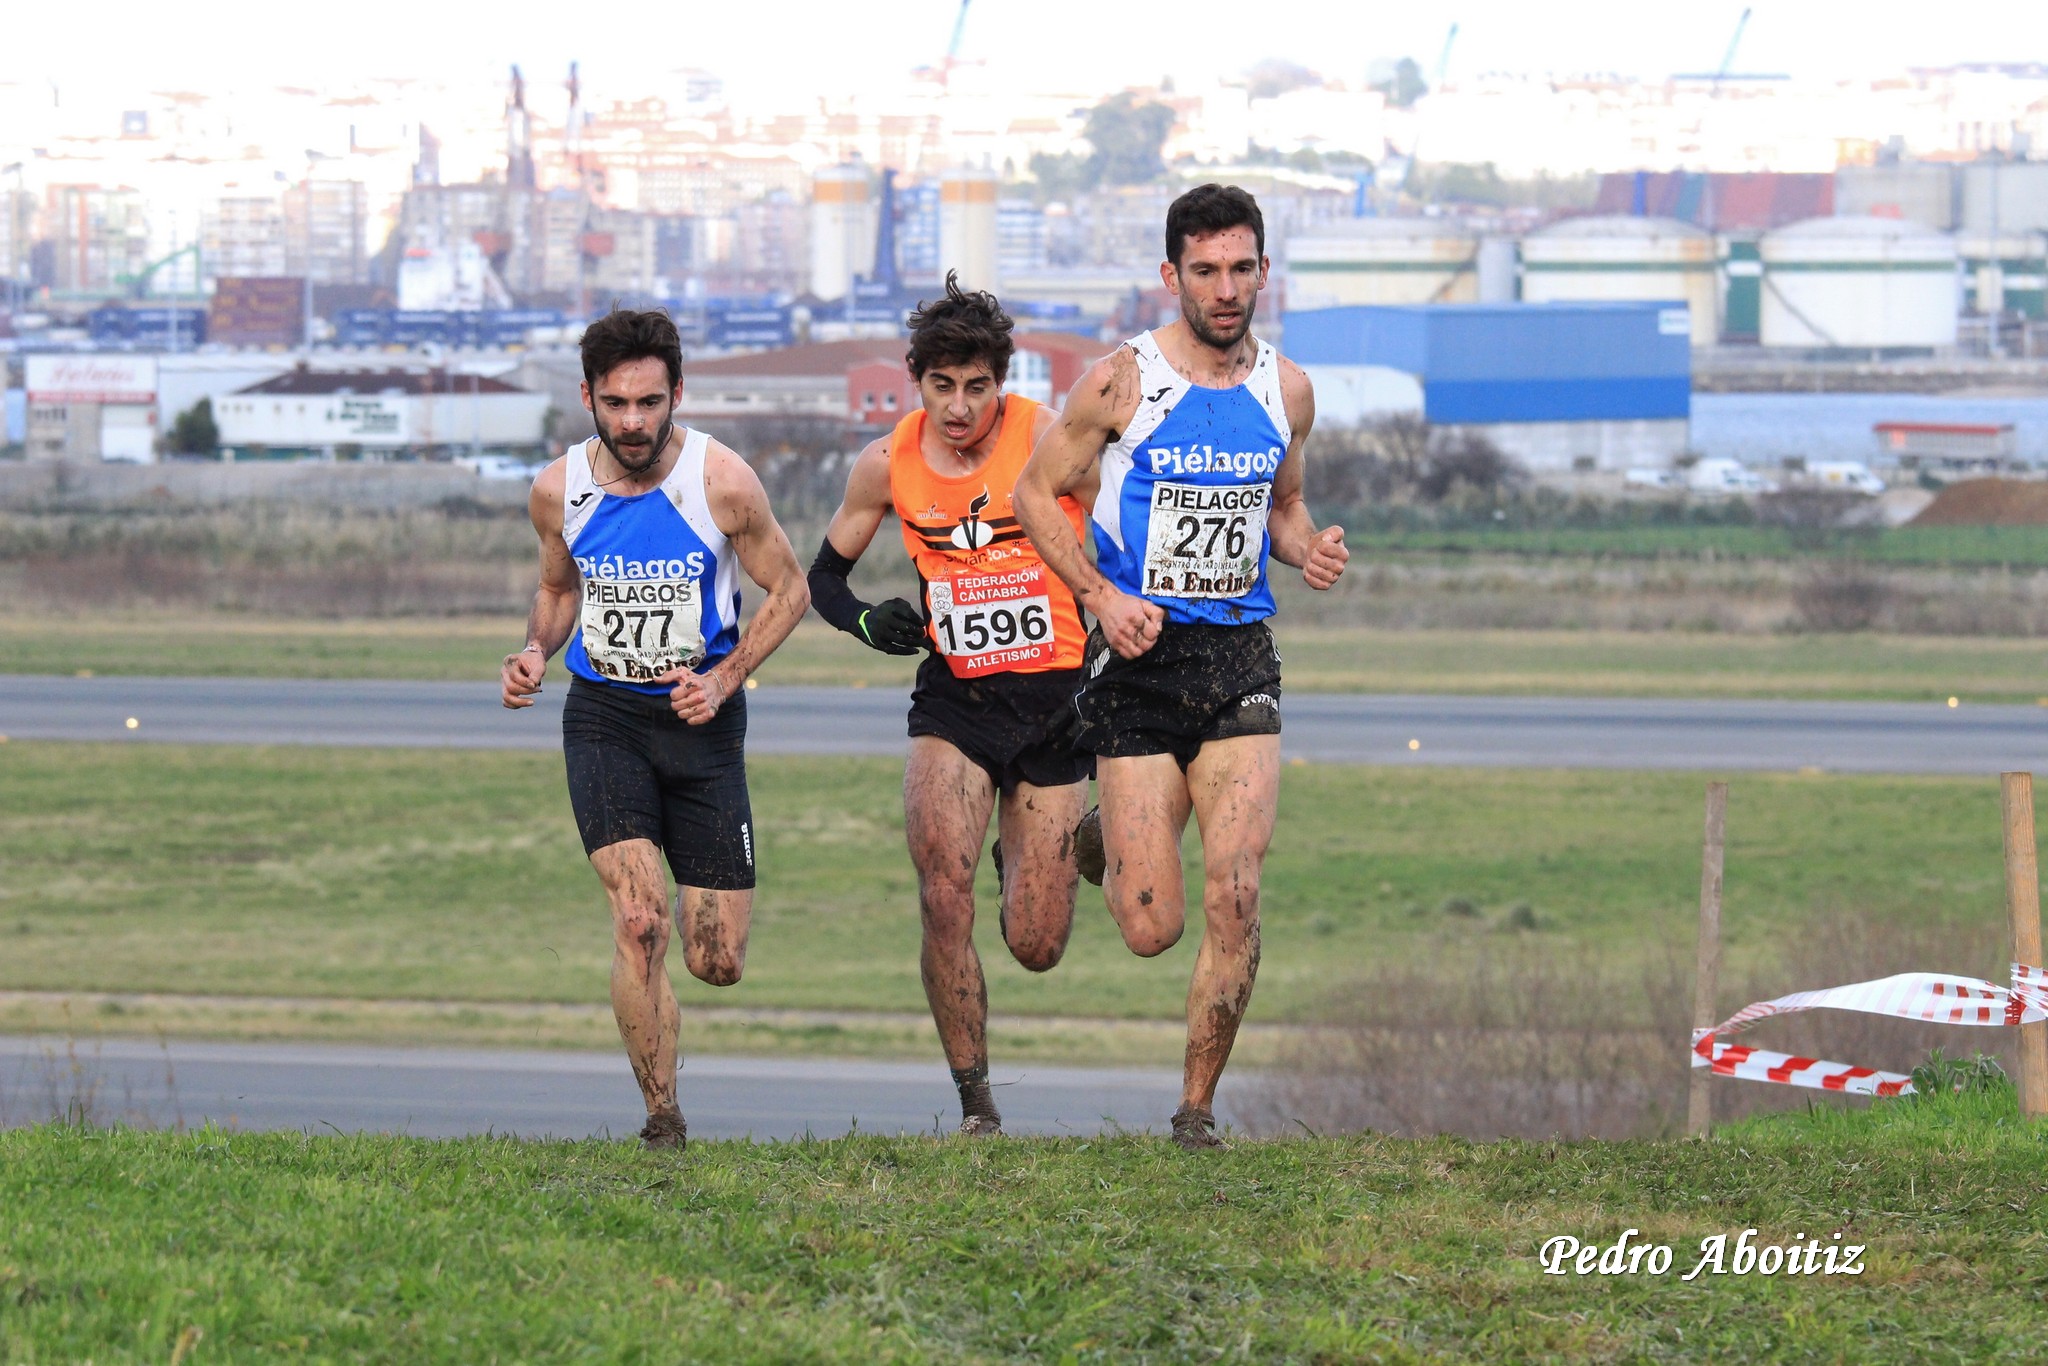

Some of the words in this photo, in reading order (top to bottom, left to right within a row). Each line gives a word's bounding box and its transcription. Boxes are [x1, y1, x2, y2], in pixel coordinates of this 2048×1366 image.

[1157, 487, 1265, 510] PIELAGOS
[1173, 516, 1247, 559] 276
[957, 570, 1039, 589] FEDERACIÓN
[1147, 568, 1175, 591] La
[587, 583, 692, 604] PIELAGOS
[959, 588, 1029, 602] CÁNTABRA
[603, 609, 674, 649] 277
[938, 604, 1048, 651] 1596
[967, 648, 1041, 669] ATLETISMO
